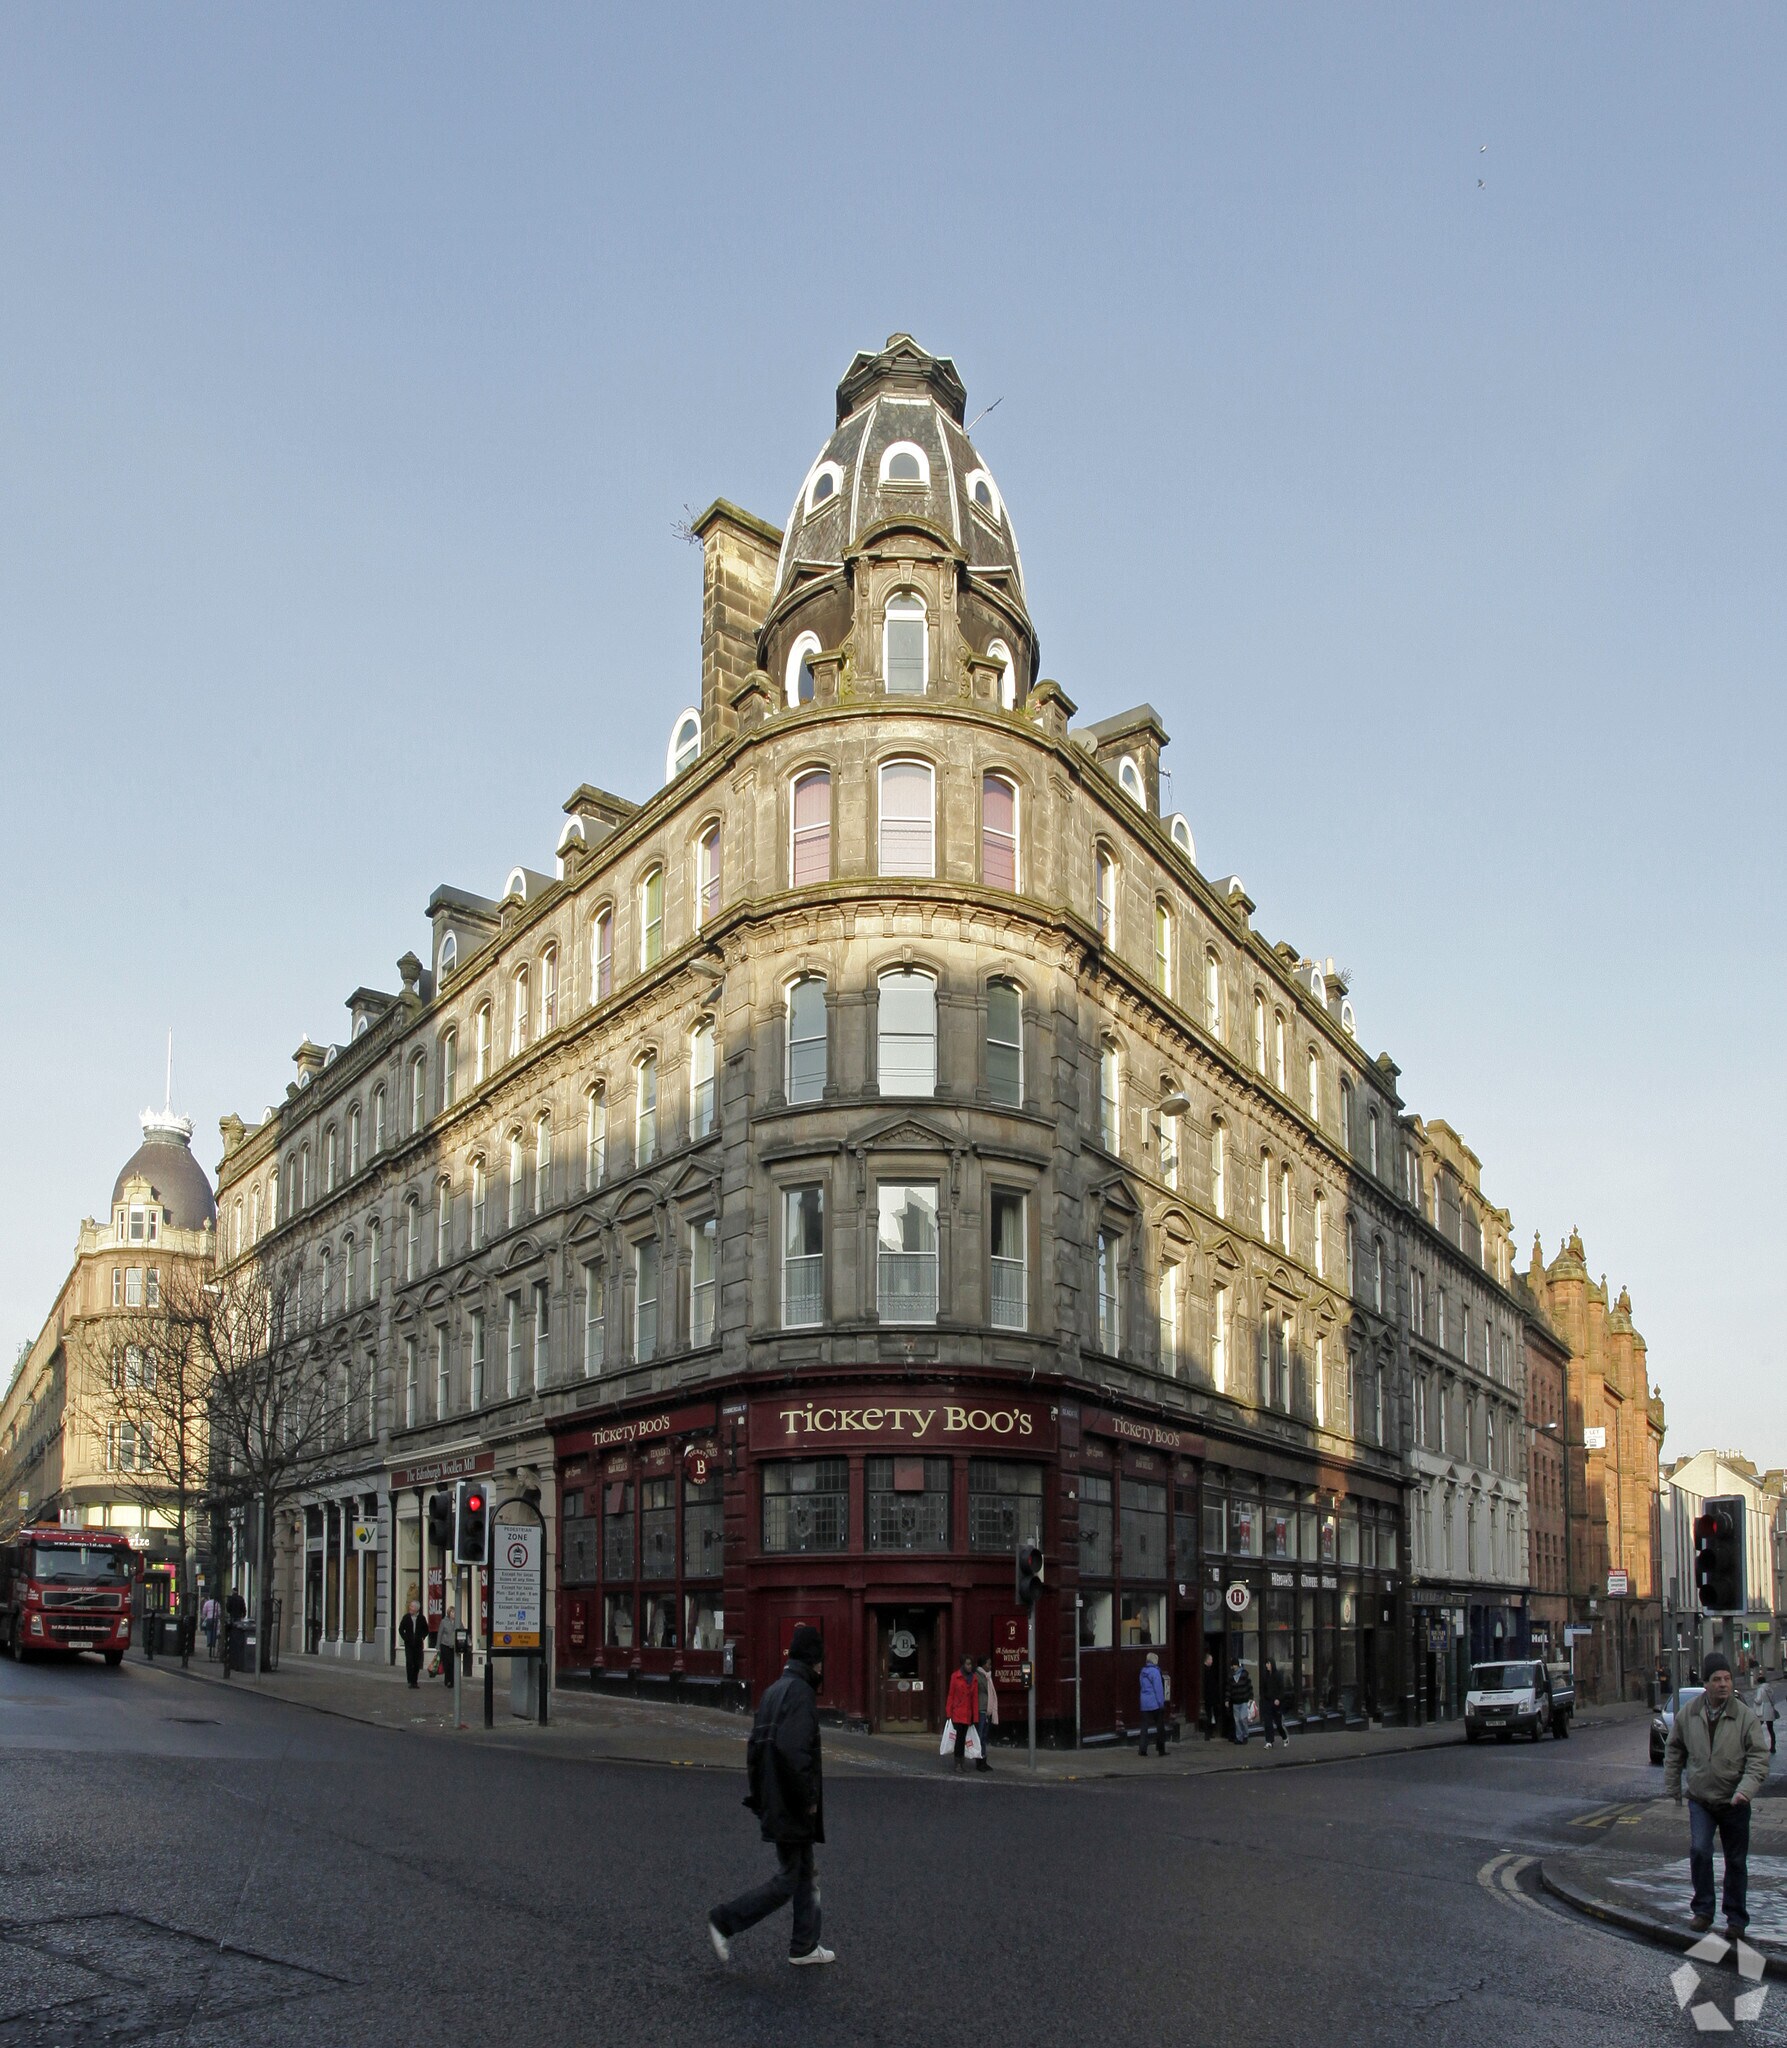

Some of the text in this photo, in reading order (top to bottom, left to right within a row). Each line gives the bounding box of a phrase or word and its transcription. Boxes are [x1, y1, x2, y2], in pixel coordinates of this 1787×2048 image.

[406, 1456, 476, 1483] The Edinburgh Woollen Mill
[696, 1460, 706, 1475] B
[508, 1533, 528, 1541] ZONE
[429, 1569, 442, 1585] SALE
[1233, 1592, 1242, 1603] H
[429, 1599, 442, 1615] SALE
[902, 1639, 909, 1649] B
